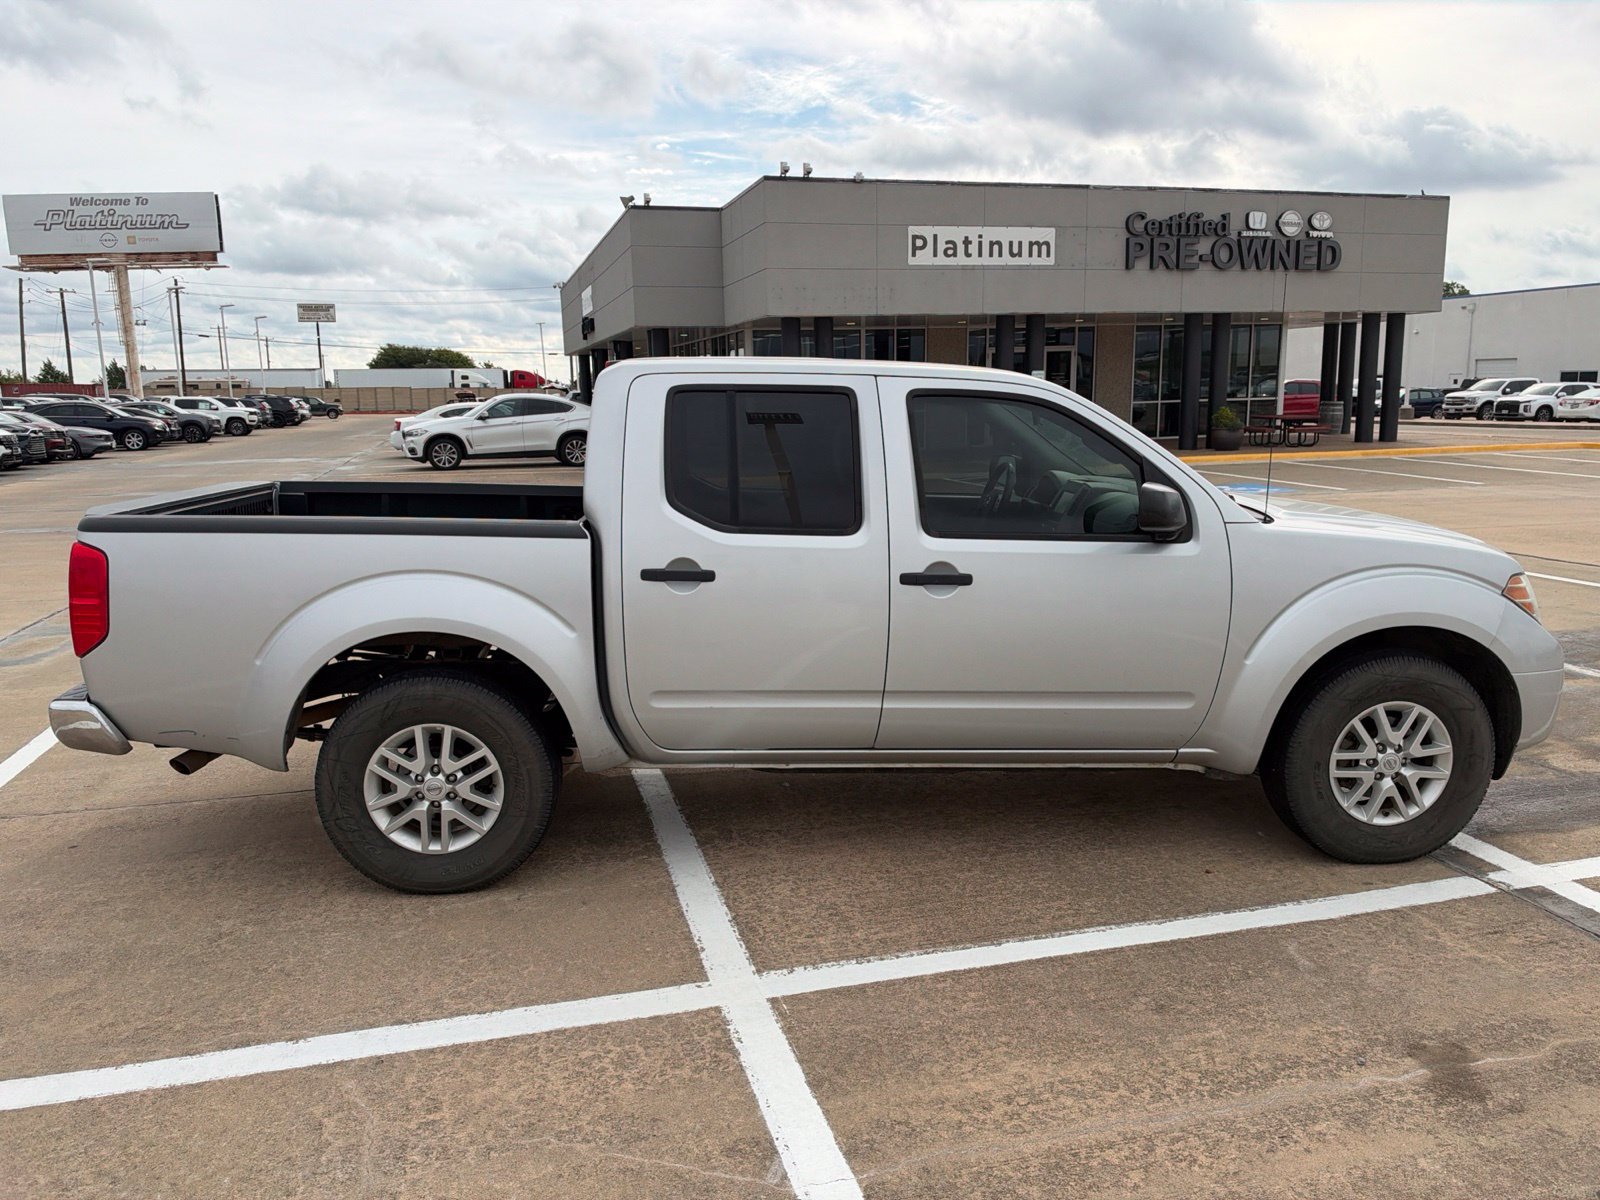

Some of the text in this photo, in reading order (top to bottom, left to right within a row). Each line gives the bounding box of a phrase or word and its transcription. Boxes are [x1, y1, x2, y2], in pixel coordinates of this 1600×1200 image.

[69, 196, 149, 207] Welcome To
[33, 208, 190, 232] Platinum
[1125, 211, 1231, 237] Certified
[910, 233, 1052, 258] Platinum
[1308, 230, 1335, 238] TOYOTA
[1125, 236, 1342, 271] PRE-OWNED
